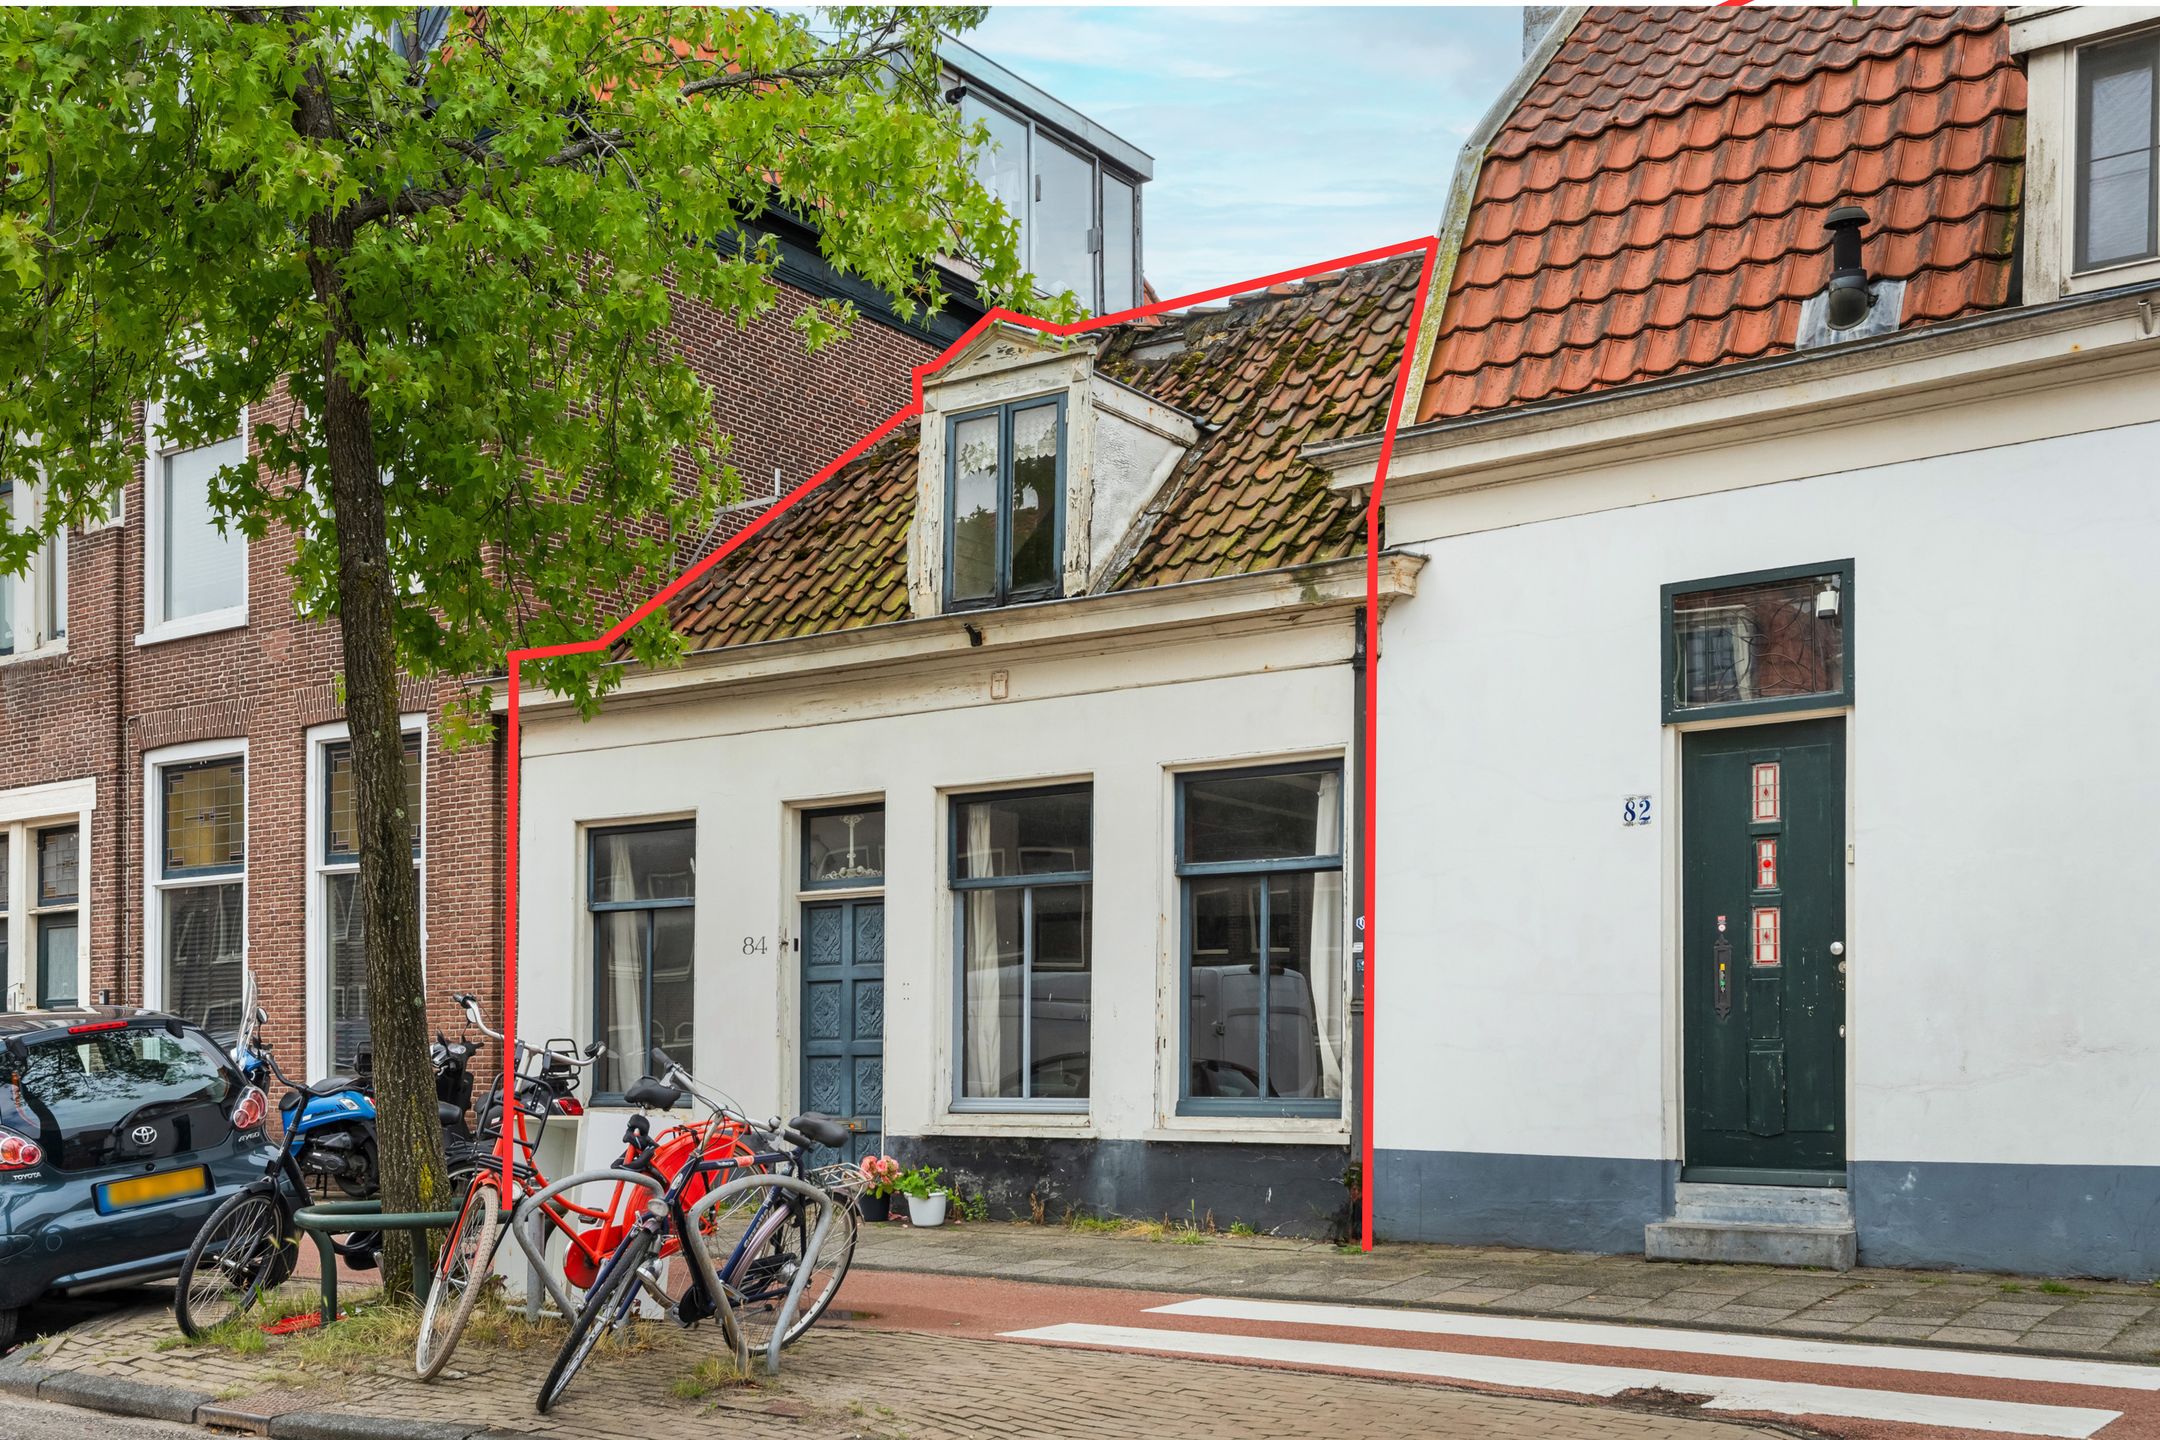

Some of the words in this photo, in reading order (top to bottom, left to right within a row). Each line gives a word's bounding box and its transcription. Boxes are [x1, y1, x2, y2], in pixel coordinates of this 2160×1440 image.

[1624, 799, 1651, 822] 82
[742, 936, 768, 956] 84
[12, 1171, 42, 1181] TOYOTA
